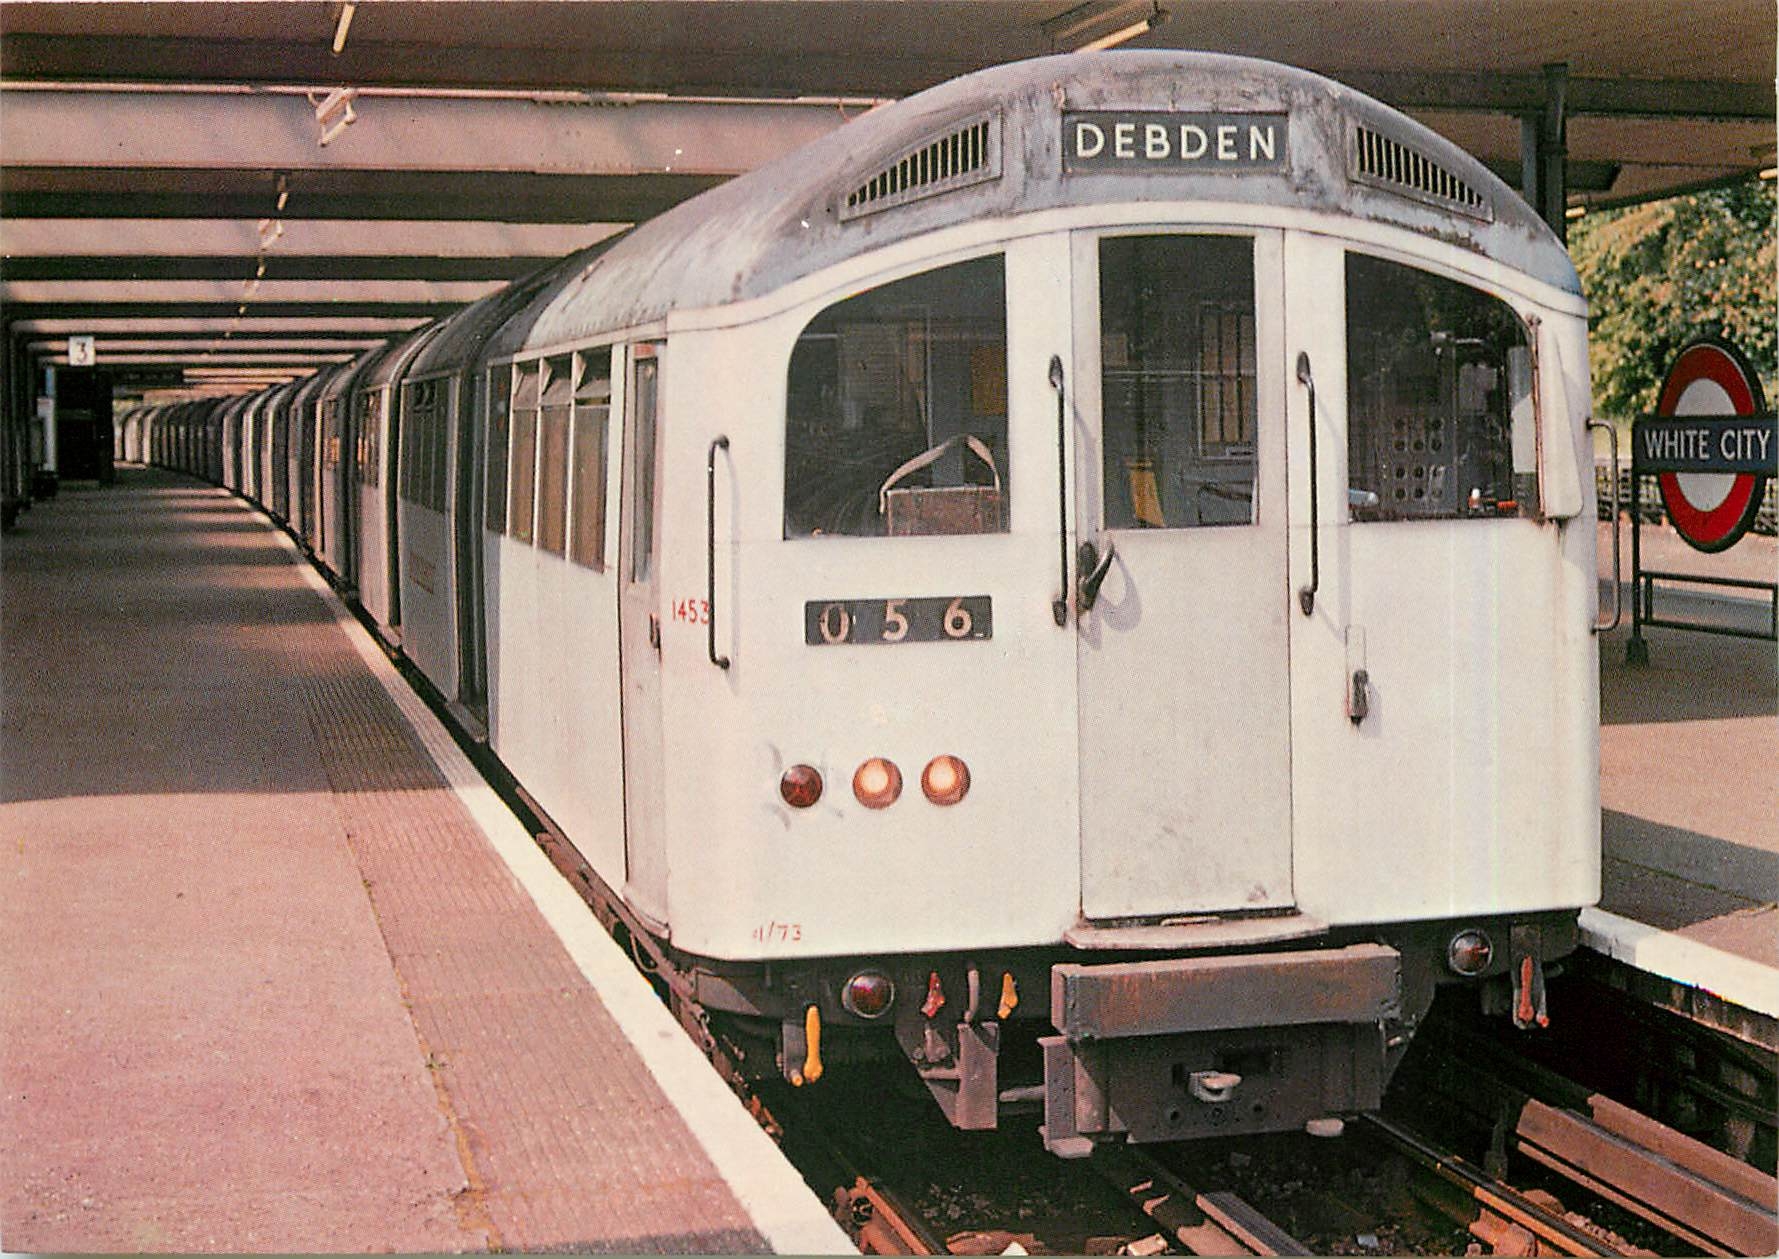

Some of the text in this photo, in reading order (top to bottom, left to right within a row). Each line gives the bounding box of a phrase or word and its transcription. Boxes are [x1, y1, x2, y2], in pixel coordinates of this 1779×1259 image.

[1076, 123, 1275, 160] DEBDEN
[76, 340, 88, 363] 3
[1644, 428, 1771, 461] WHITE CITY
